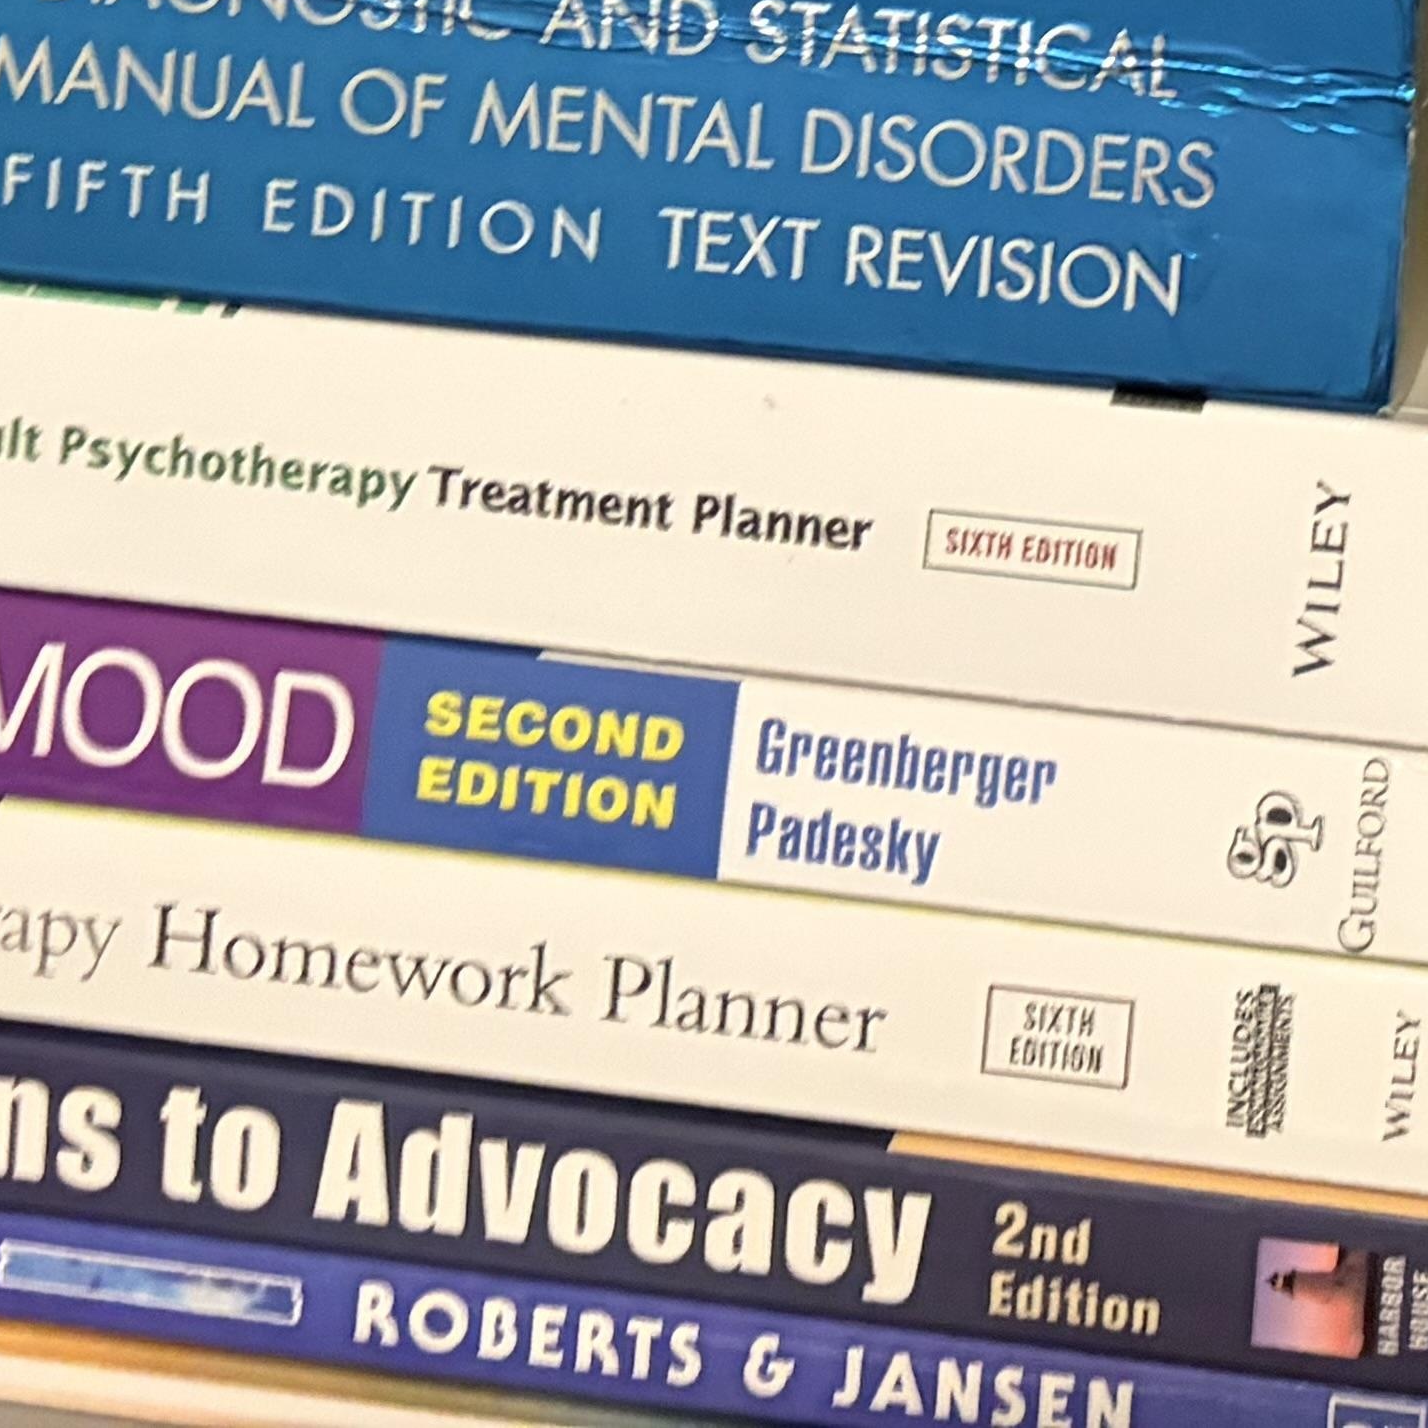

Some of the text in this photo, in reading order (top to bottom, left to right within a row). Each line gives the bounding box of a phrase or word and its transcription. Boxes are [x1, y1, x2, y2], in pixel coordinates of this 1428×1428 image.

[340, 66, 446, 137] OF
[470, 78, 775, 173] MENTAL
[800, 108, 1218, 210] DISORDERS
[1, 153, 1184, 316] FIFTH EDITION TEXT REVISION
[58, 425, 417, 513] Psychotherapy
[428, 464, 673, 533] Treatment
[692, 495, 873, 552] Planner
[945, 526, 1120, 571] SIXTH EDITION
[1290, 479, 1353, 680] WILEY
[426, 690, 685, 764] SECOND
[756, 717, 1059, 808] Greenberger
[415, 755, 678, 829] EDITION
[745, 800, 943, 887] Padesky
[1336, 755, 1393, 955] GUILFORD
[149, 902, 571, 1017] Homework
[600, 953, 888, 1053] Planner
[1023, 1000, 1096, 1037] SIXTH
[1008, 1036, 1103, 1076] EDITION
[1226, 988, 1253, 1128] INCLUDES
[1381, 1009, 1421, 1141] WILEY
[159, 1085, 281, 1208] to
[313, 1101, 931, 1305] Advocacy
[992, 1202, 1091, 1265] 2nd
[352, 1280, 1135, 1428] ROBERTS & JANSEN
[987, 1268, 1162, 1337] Edition
[1377, 1255, 1406, 1356] HARBOR
